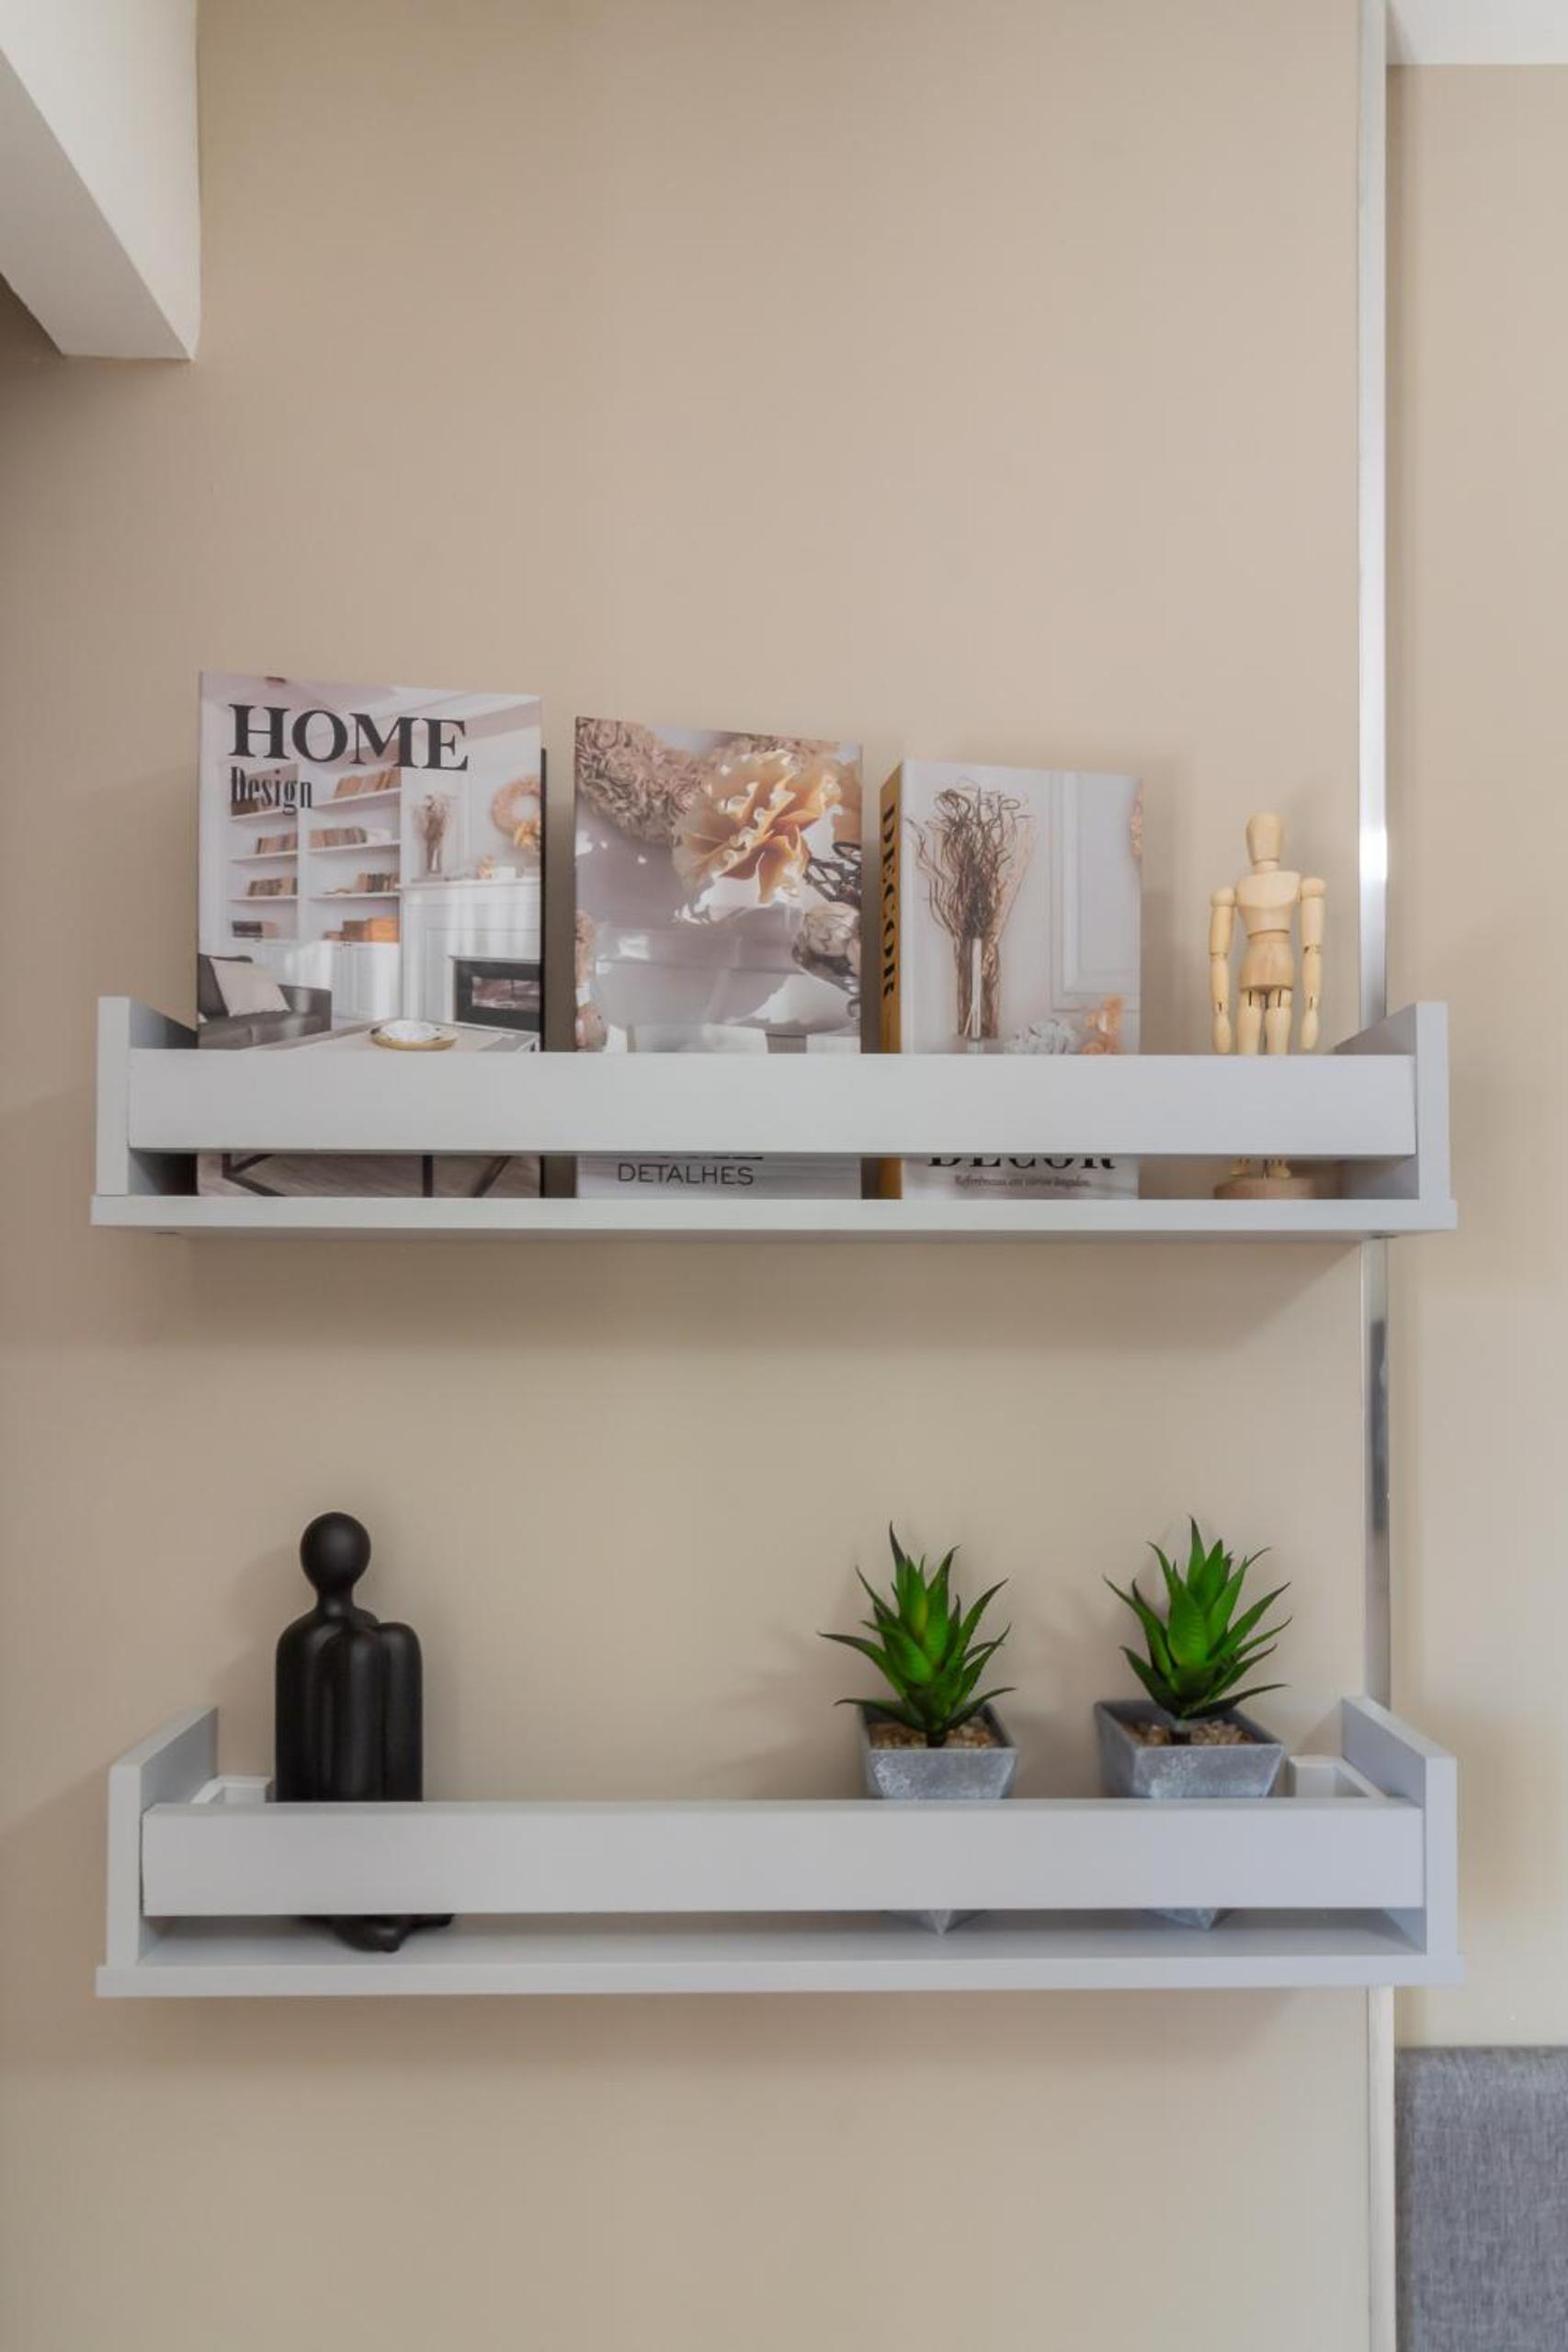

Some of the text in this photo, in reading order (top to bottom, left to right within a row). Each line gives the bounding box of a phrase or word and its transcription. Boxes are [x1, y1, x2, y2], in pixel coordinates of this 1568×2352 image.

[228, 703, 469, 771] HOME
[231, 766, 312, 815] Design
[618, 1163, 754, 1186] DETALHES
